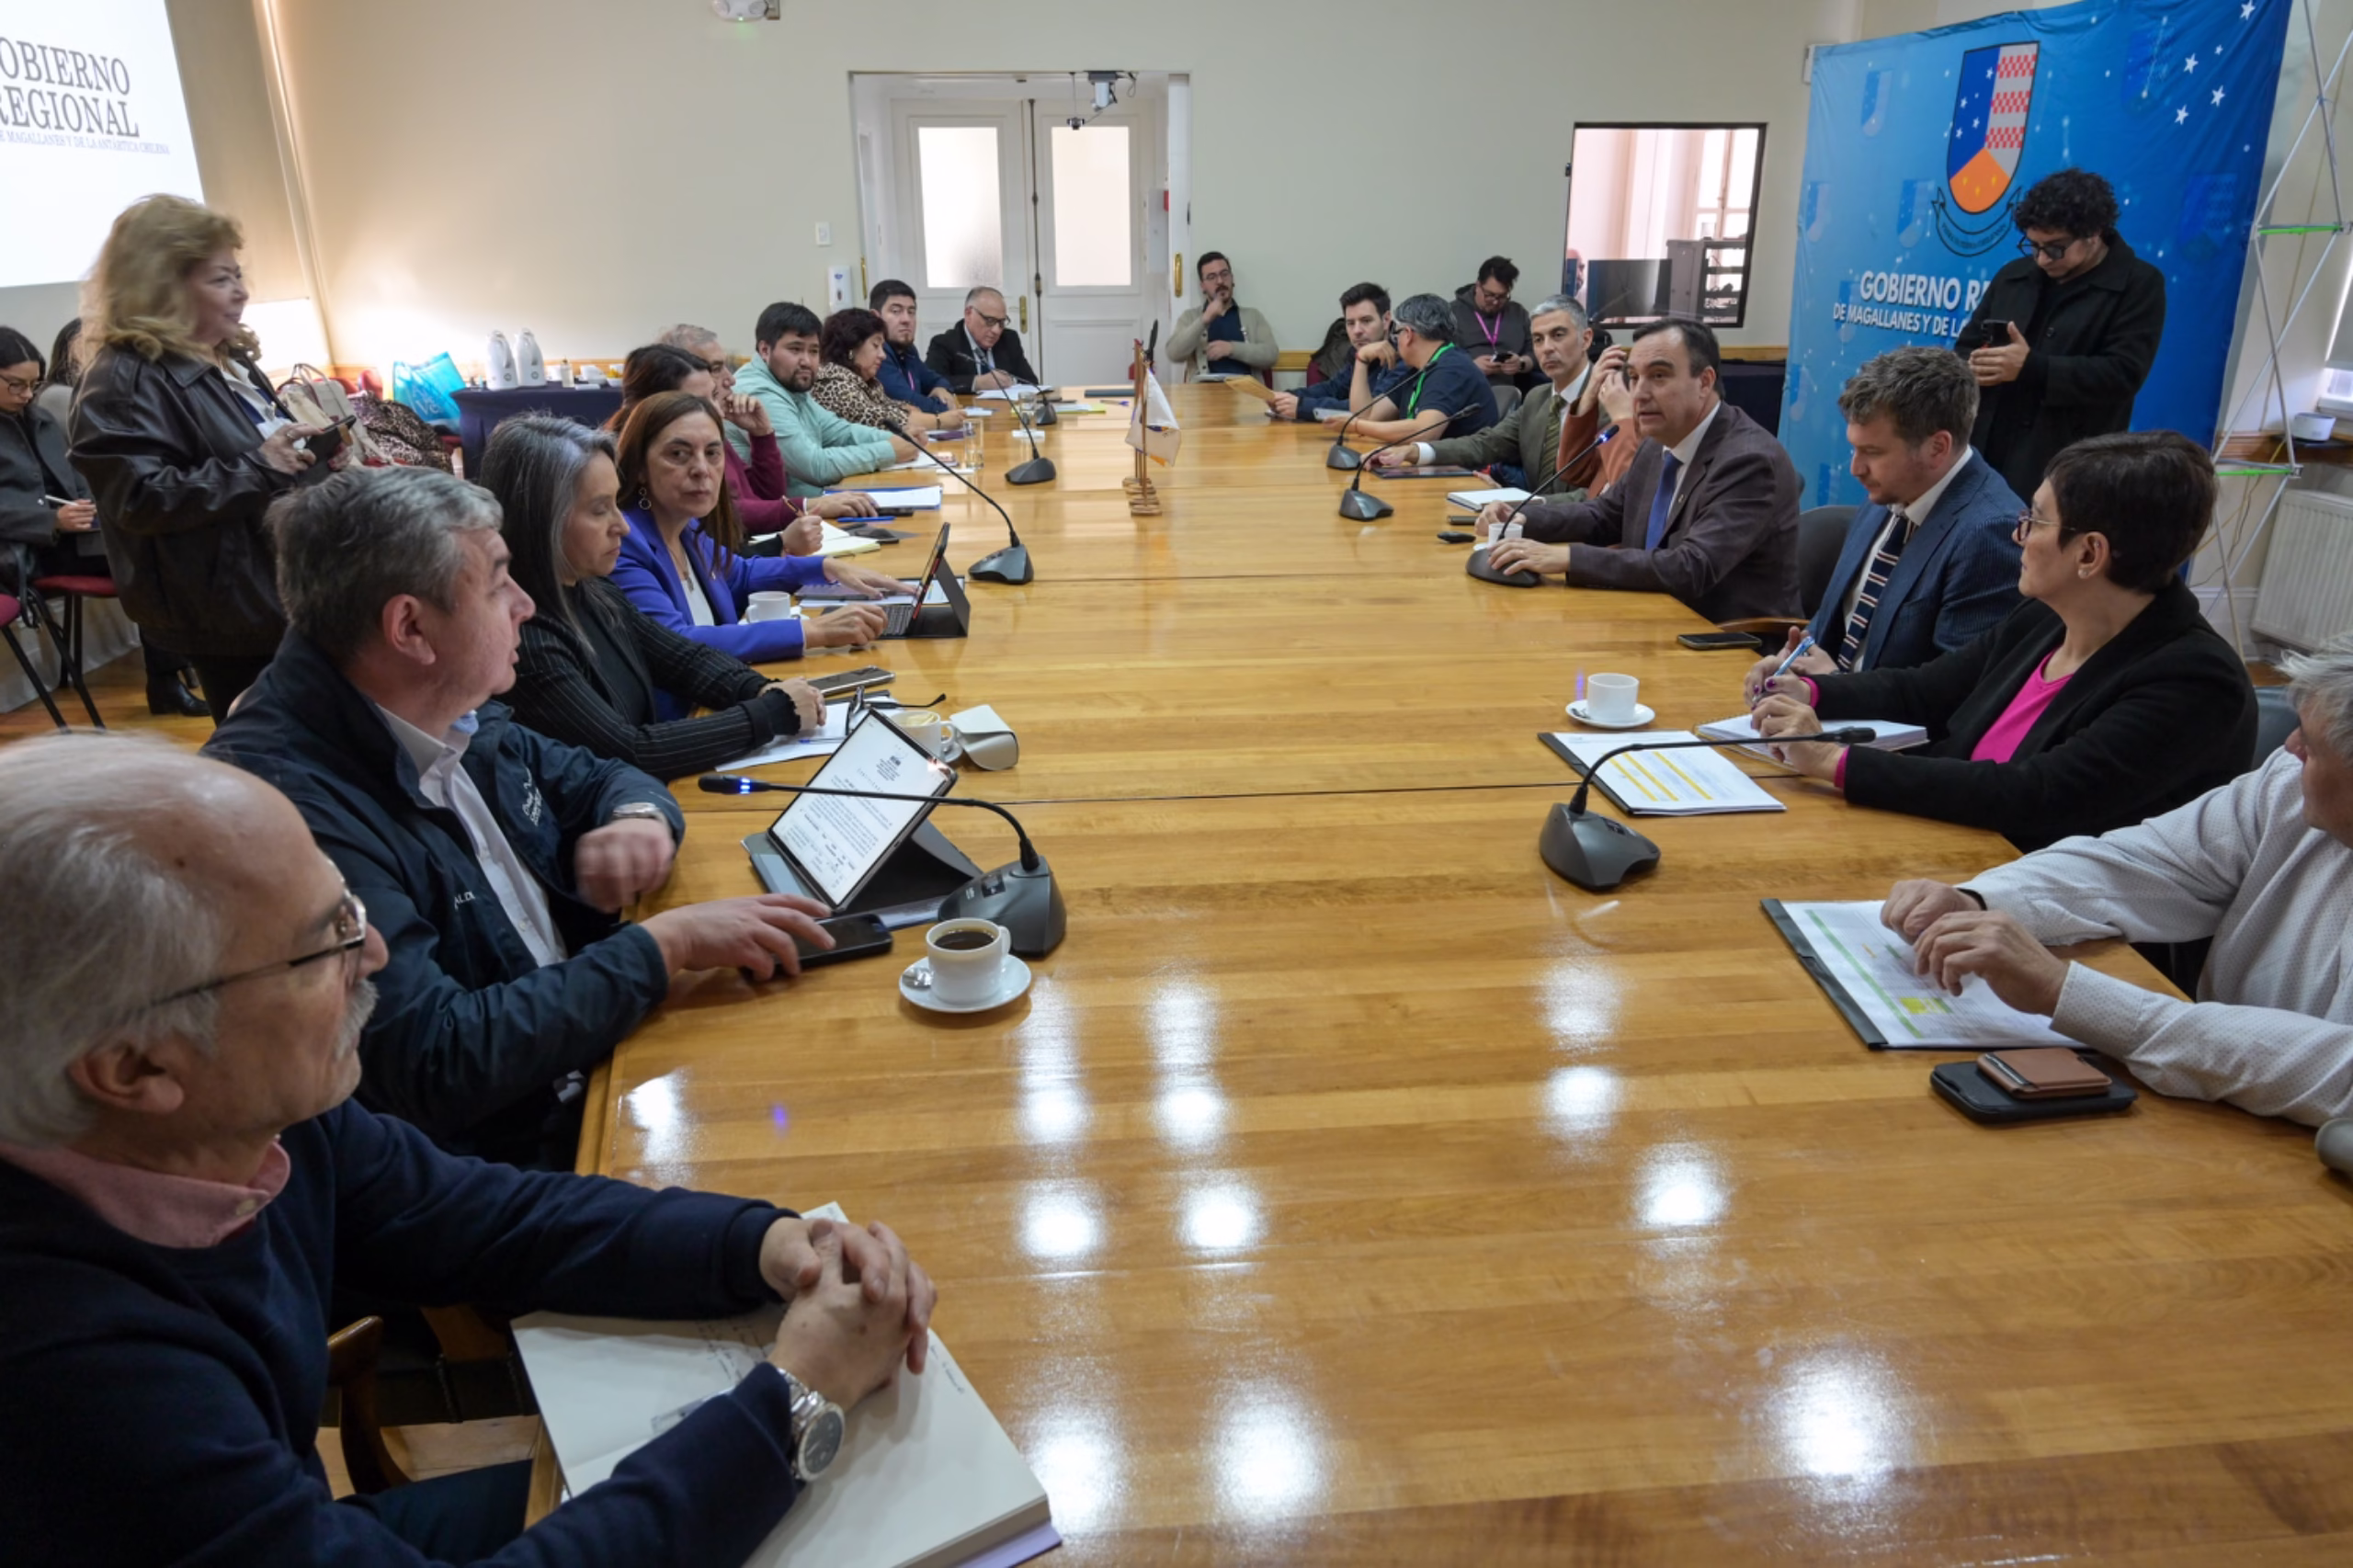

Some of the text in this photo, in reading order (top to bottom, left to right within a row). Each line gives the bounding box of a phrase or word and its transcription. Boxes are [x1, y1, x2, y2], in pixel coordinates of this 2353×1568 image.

[1859, 270, 1961, 311] GOBIERNO
[1833, 302, 1847, 320] DE
[1847, 304, 1919, 332] MAGALLANES
[1922, 314, 1932, 334] Y
[1932, 316, 1949, 335] DE
